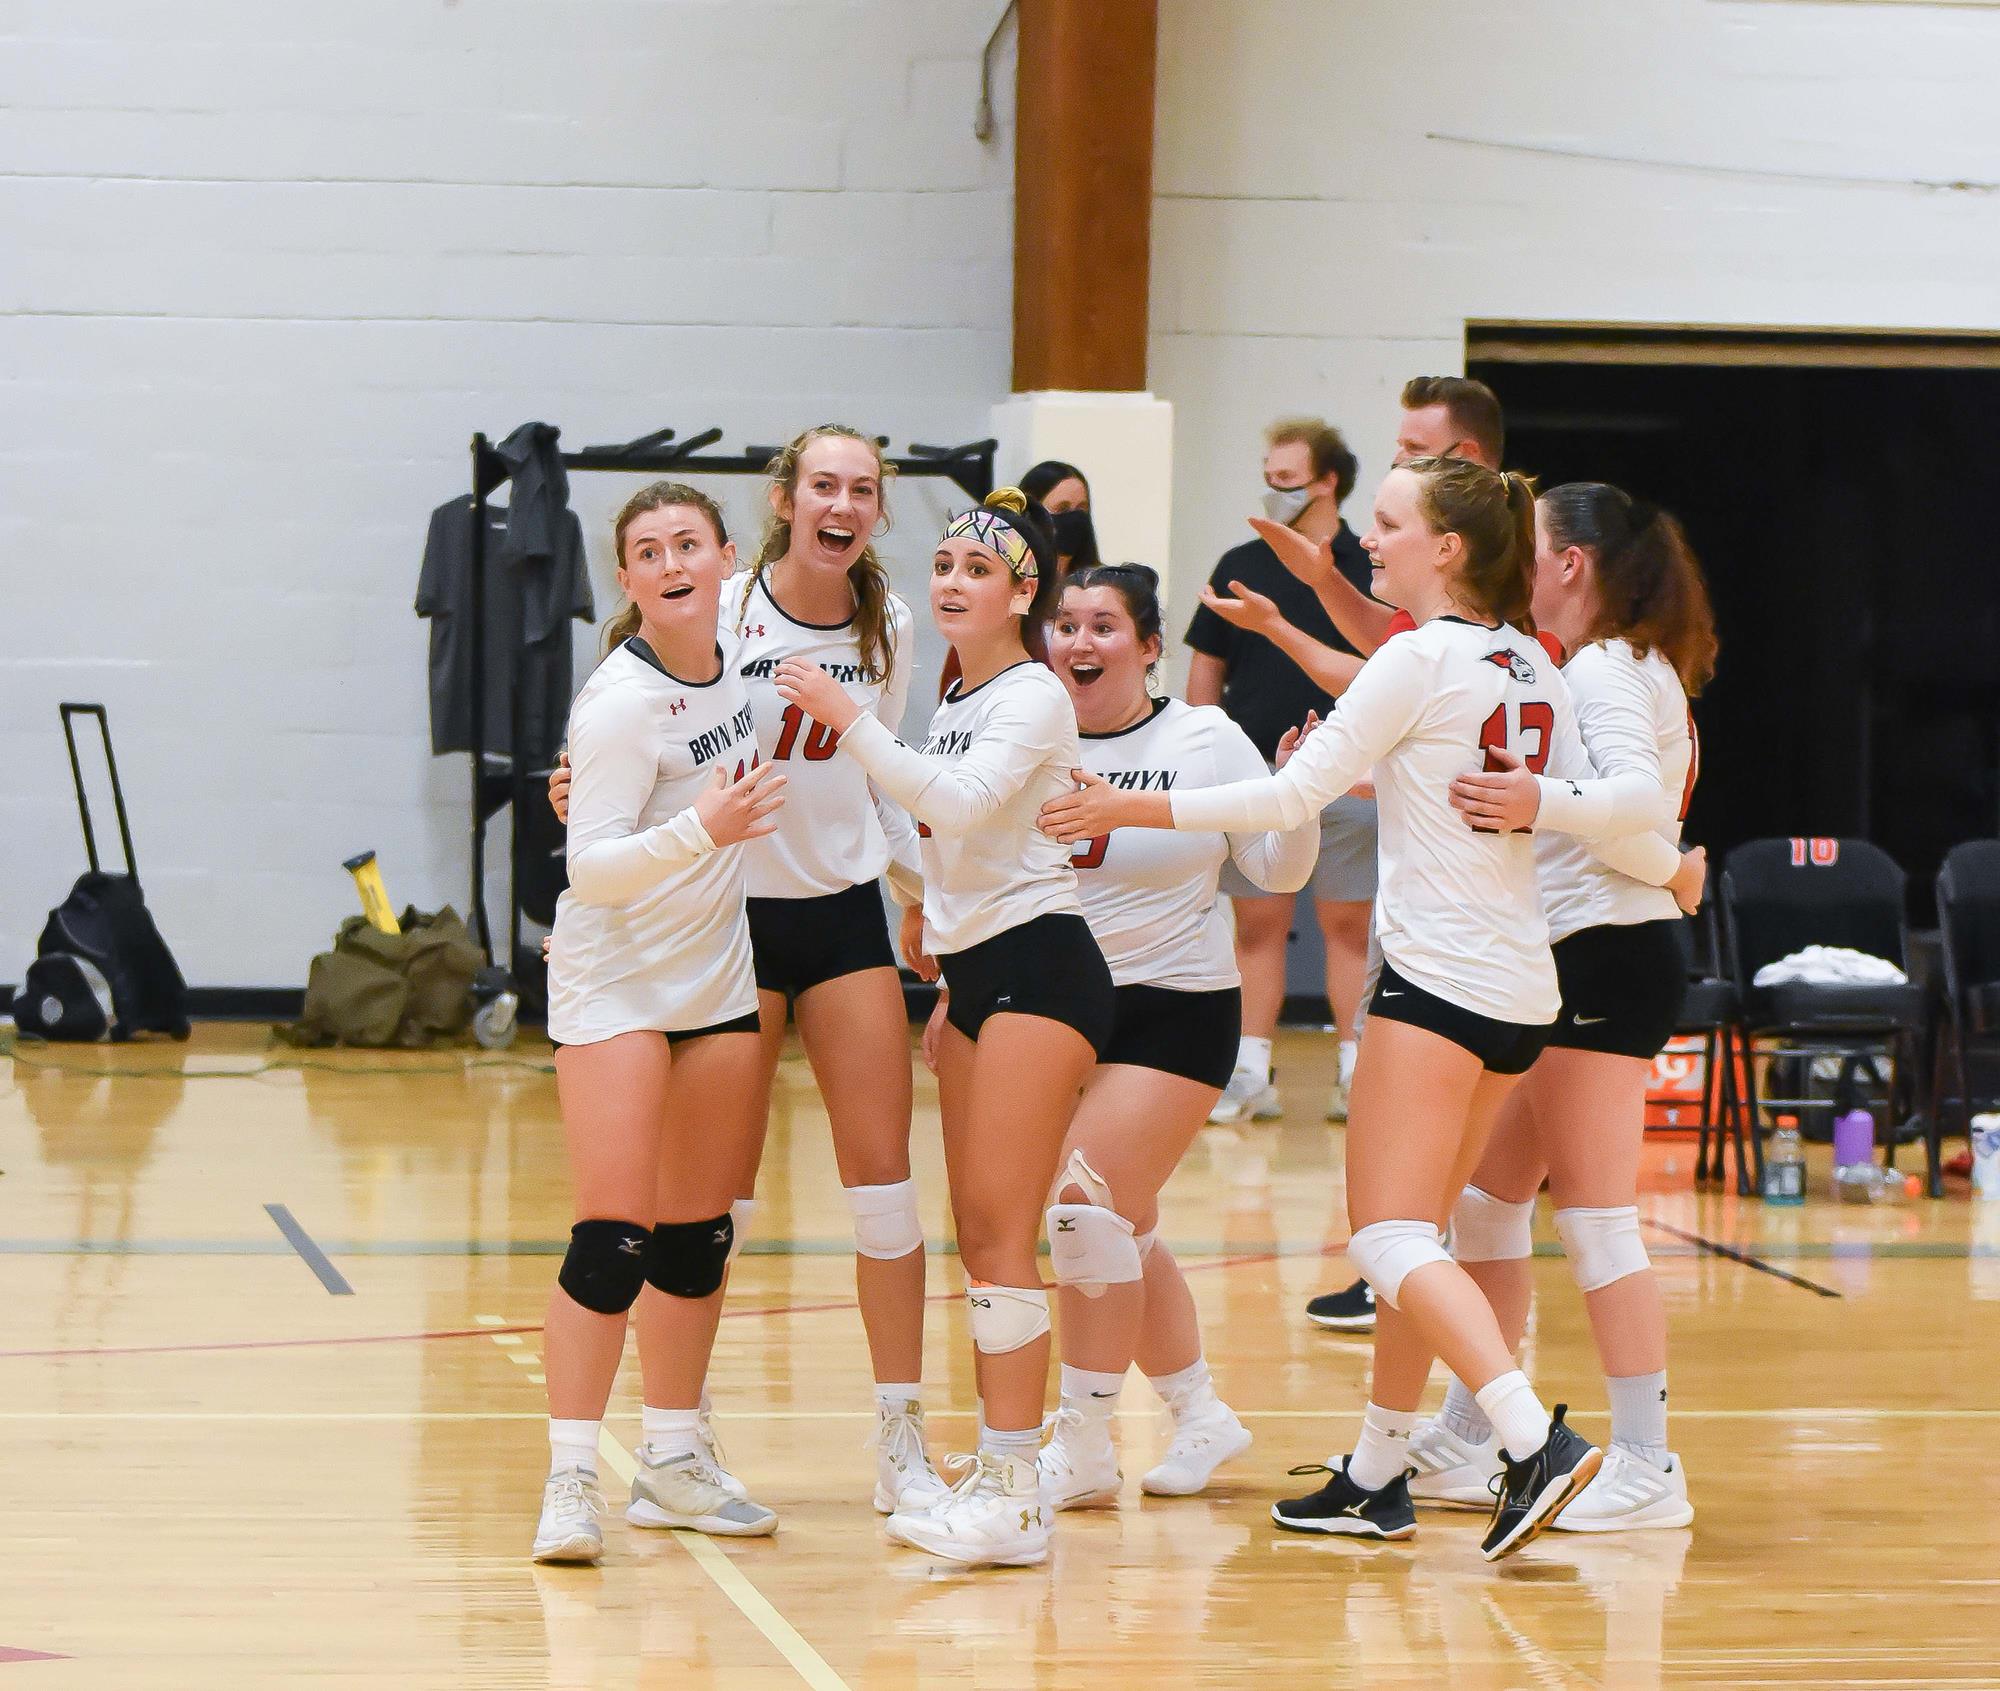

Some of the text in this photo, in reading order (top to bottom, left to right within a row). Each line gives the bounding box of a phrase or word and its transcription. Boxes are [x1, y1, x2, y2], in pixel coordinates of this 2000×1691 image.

[688, 722, 732, 767] BRYN
[732, 698, 755, 743] ATH
[1096, 770, 1178, 791] THYN
[1789, 836, 1839, 866] 10
